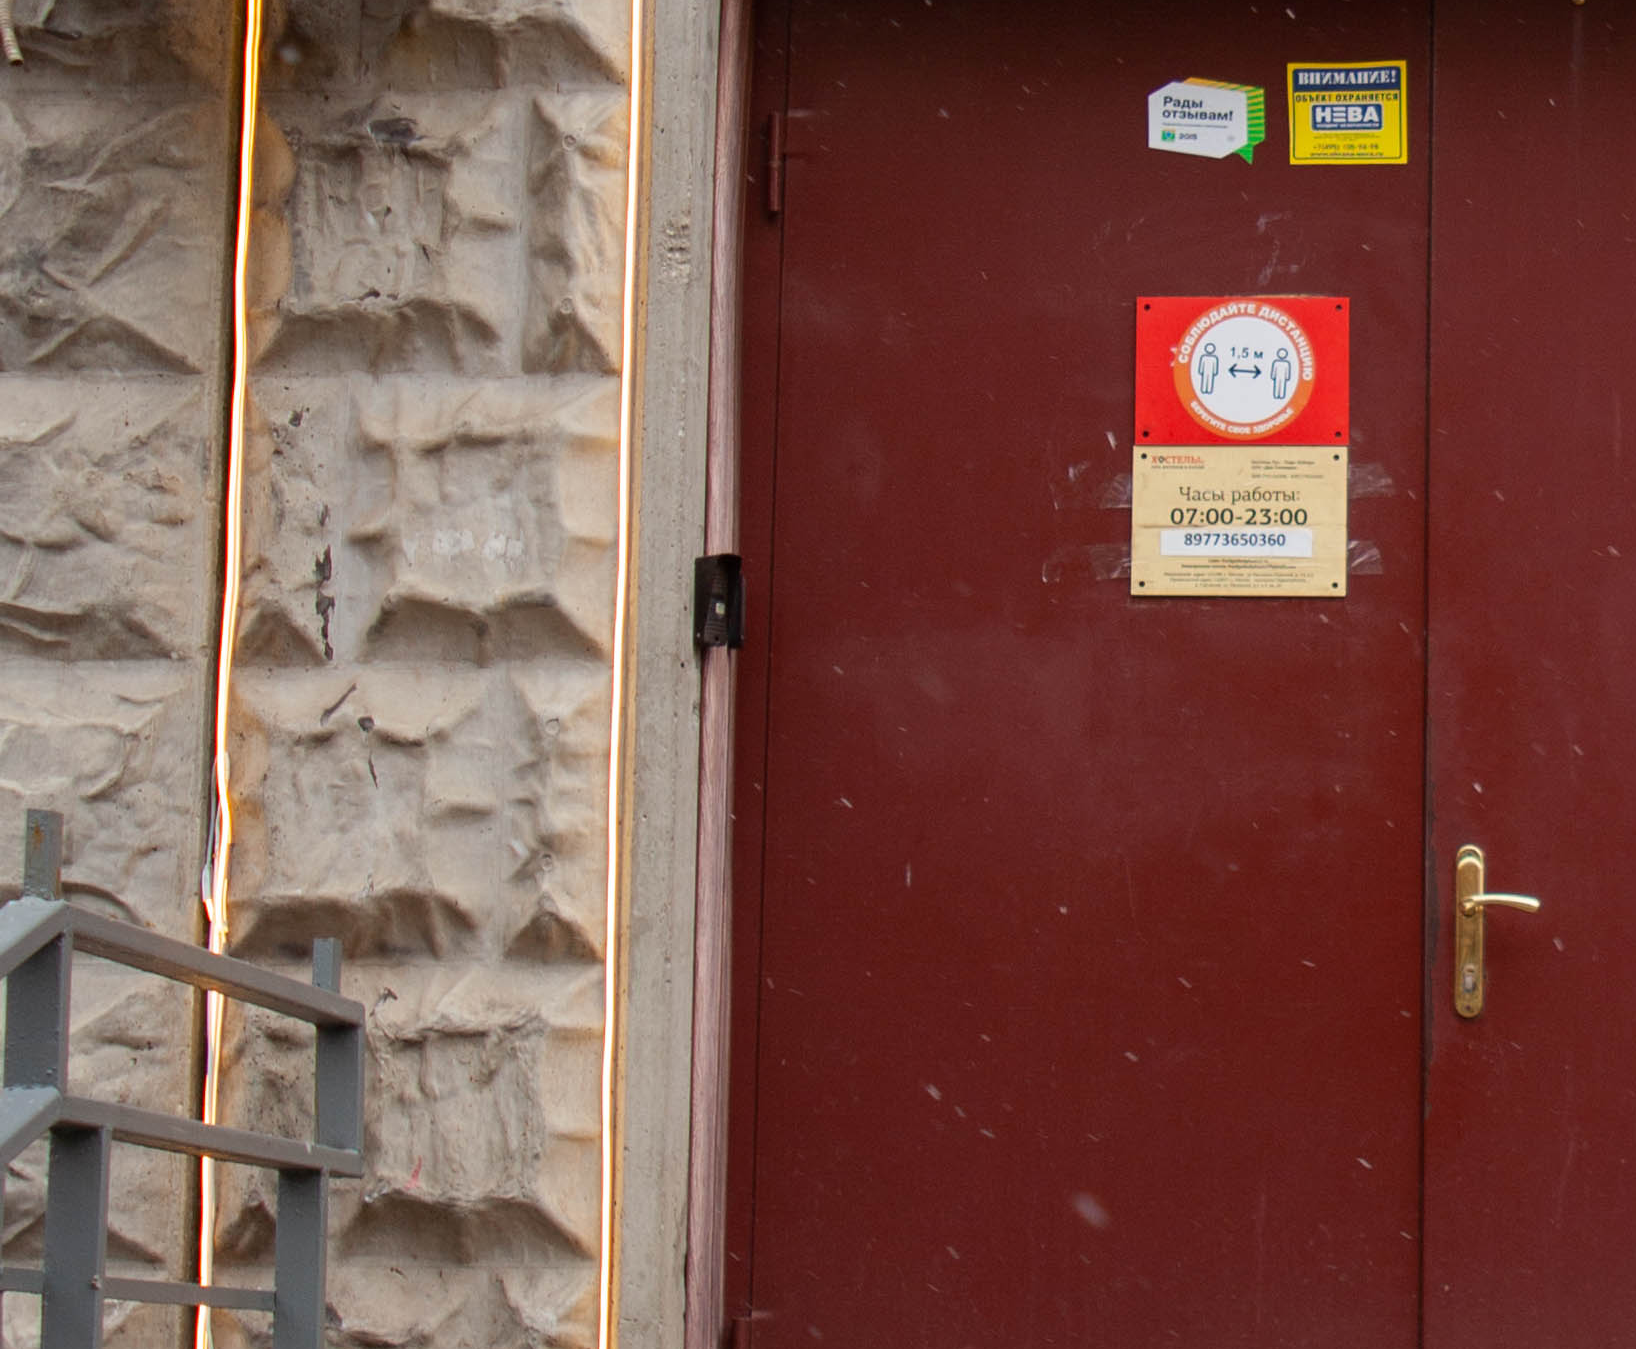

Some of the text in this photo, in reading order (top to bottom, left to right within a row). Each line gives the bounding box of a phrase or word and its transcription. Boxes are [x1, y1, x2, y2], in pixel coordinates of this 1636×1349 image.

[1297, 69, 1398, 86] ВНИМАНИЕ!
[1163, 95, 1203, 109] Рады
[1295, 93, 1399, 102] ОБЪЕКТ ОХРАНЯЕТСЯ
[1162, 109, 1234, 121] отзывам!
[1315, 106, 1379, 123] НЕВА
[1178, 302, 1313, 382] СОБЛЮДАЙТЕ ДИСТАНЦИЮ
[1230, 347, 1264, 359] 1,5 м
[1178, 486, 1301, 505] Часы работы:
[1170, 508, 1308, 526] 07:00-23:00
[1183, 533, 1286, 547] 89773650360
